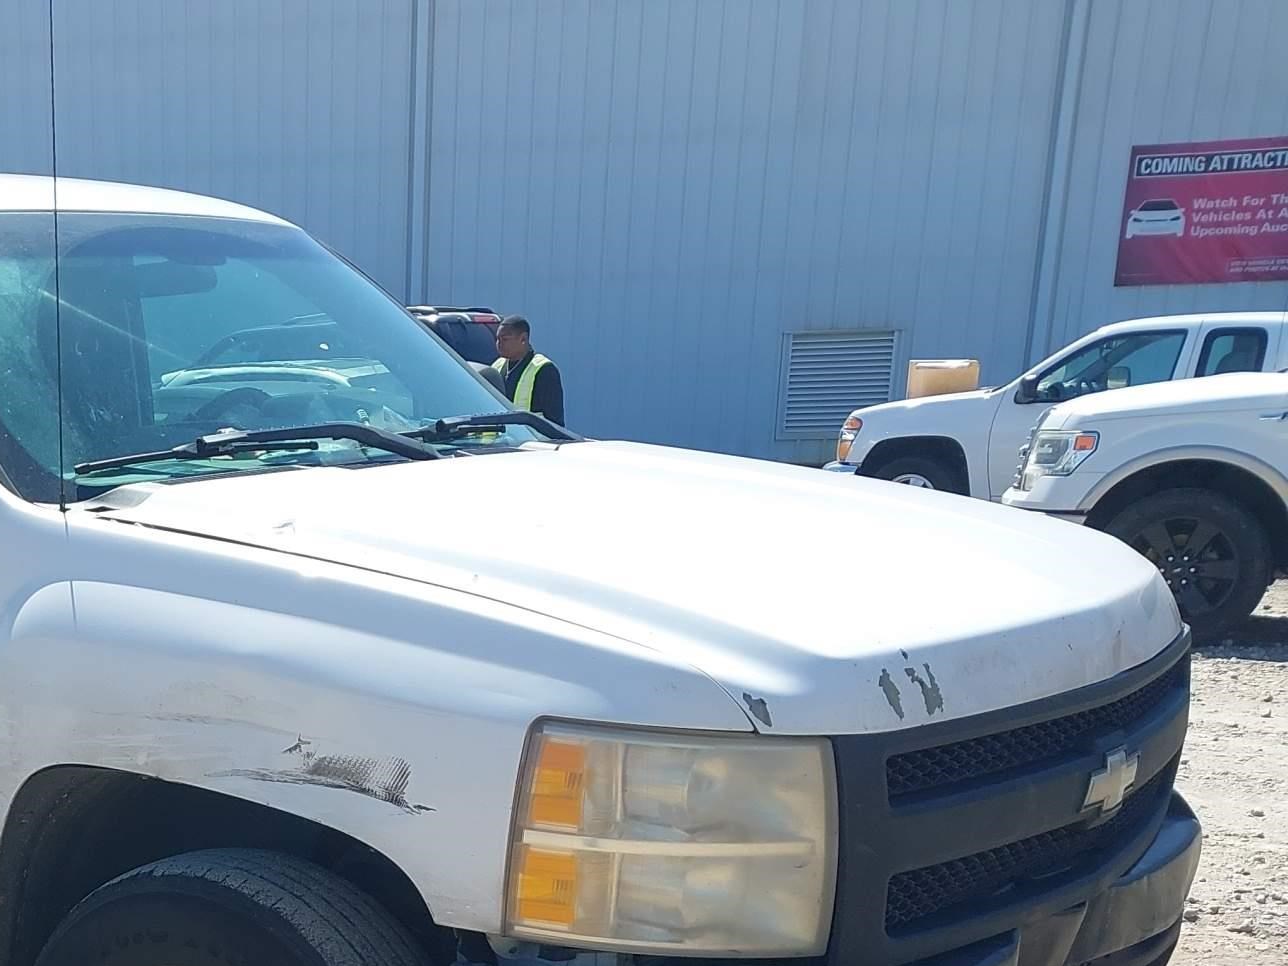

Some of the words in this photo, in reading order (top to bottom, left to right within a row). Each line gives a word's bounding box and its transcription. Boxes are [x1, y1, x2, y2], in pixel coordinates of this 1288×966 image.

[1140, 155, 1206, 175] COMING
[1193, 196, 1237, 209] Watch
[1242, 195, 1266, 206] For
[1192, 210, 1252, 223] Vehicles
[1255, 208, 1274, 220] At
[1191, 223, 1259, 238] Upcoming
